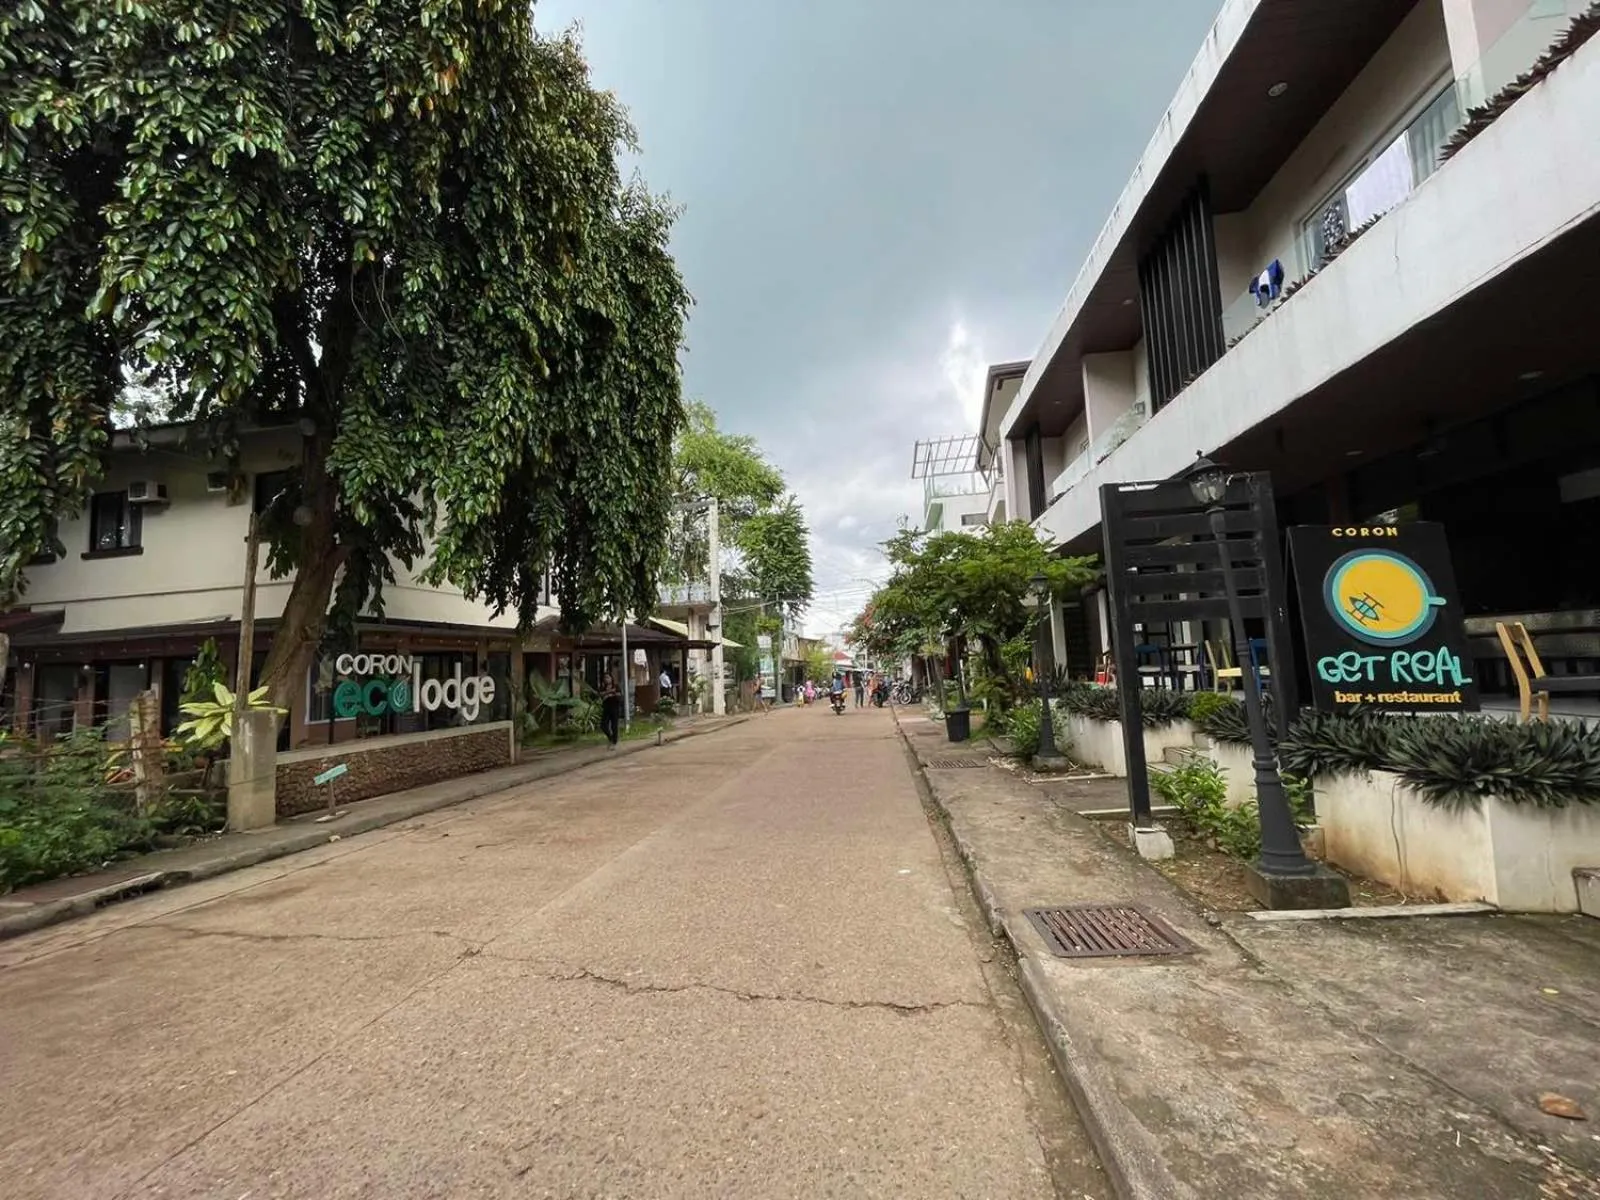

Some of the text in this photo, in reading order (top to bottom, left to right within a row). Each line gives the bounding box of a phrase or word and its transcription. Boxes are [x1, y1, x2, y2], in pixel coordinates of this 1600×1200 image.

[1331, 526, 1399, 537] CORON
[336, 653, 414, 675] CORON
[1335, 690, 1363, 703] bar
[1377, 691, 1462, 703] restaurant
